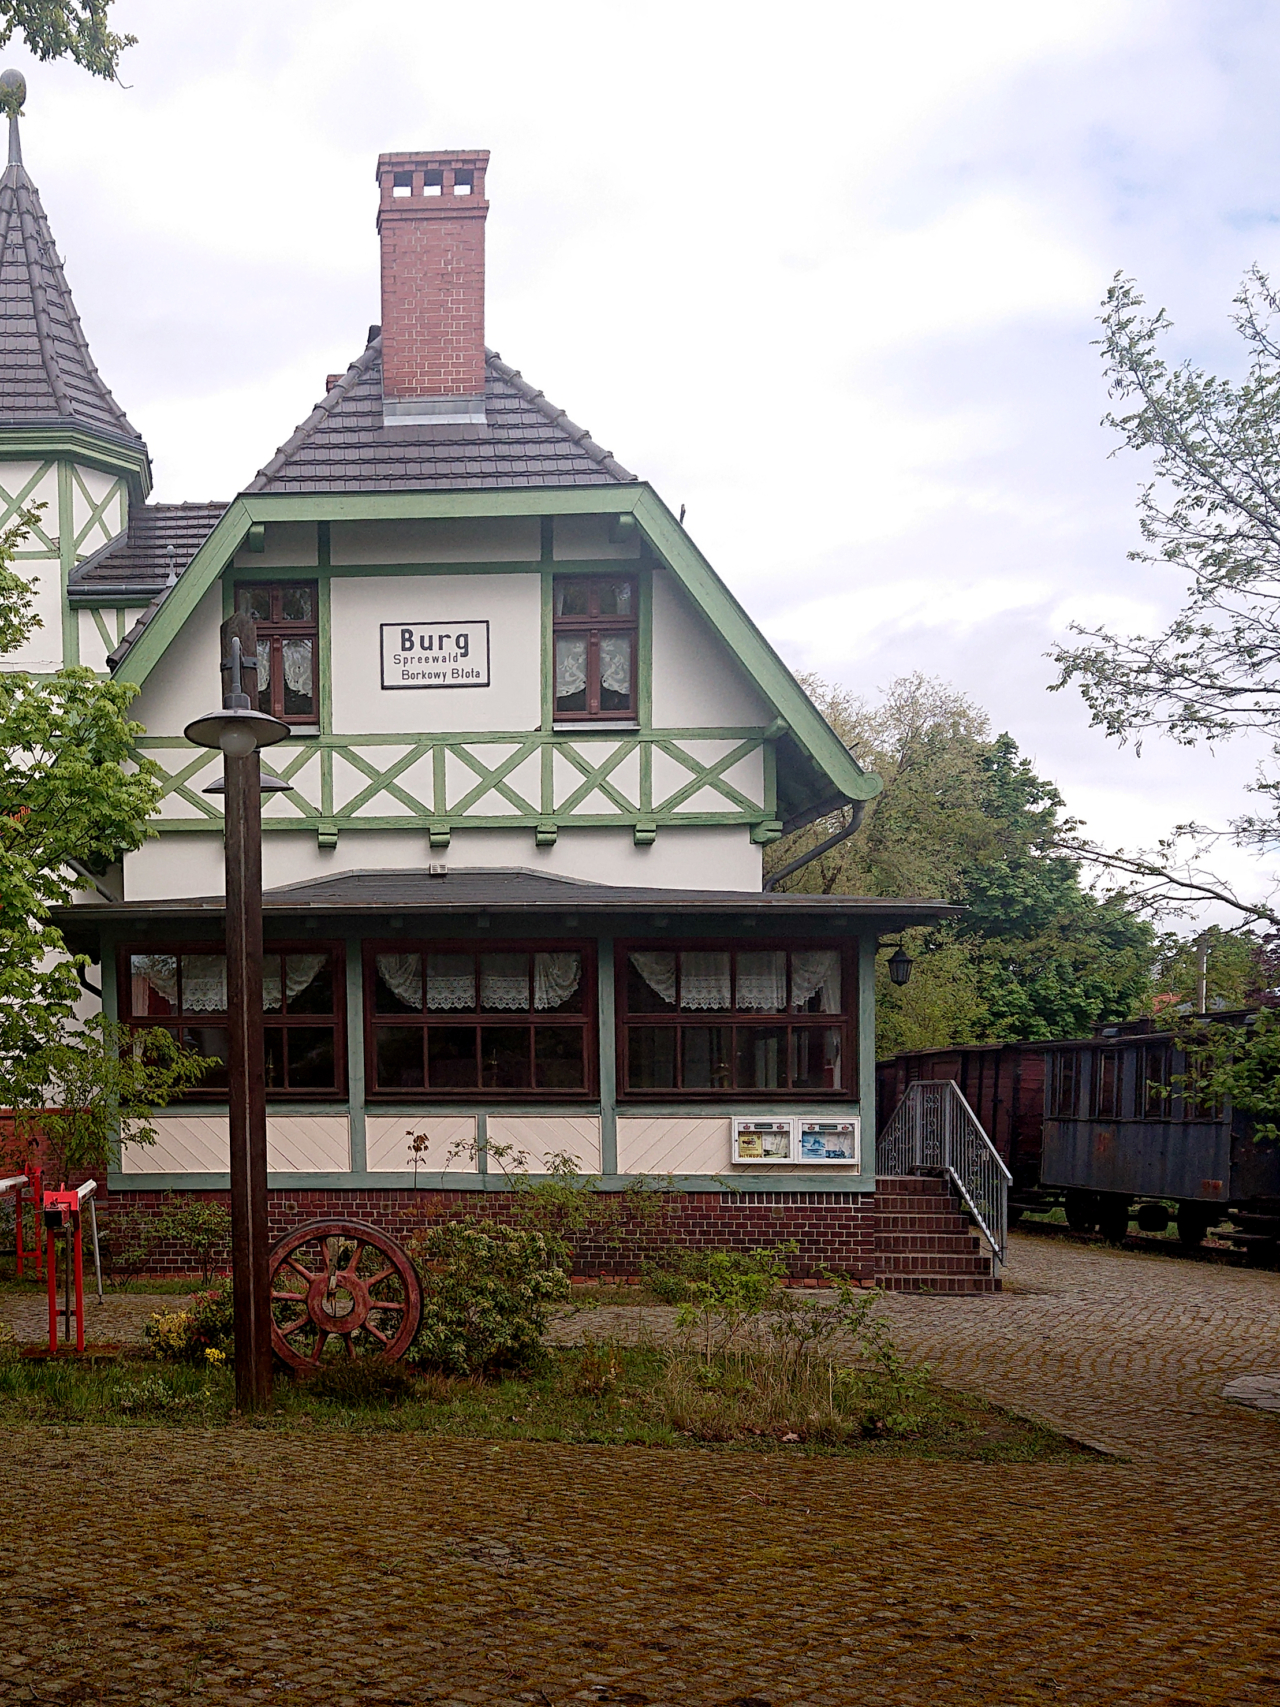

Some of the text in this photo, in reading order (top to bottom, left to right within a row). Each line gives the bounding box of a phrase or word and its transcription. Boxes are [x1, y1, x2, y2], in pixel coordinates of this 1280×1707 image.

[401, 628, 469, 657] Burg
[393, 652, 458, 667] Spreewald
[401, 669, 447, 682] Borkowy
